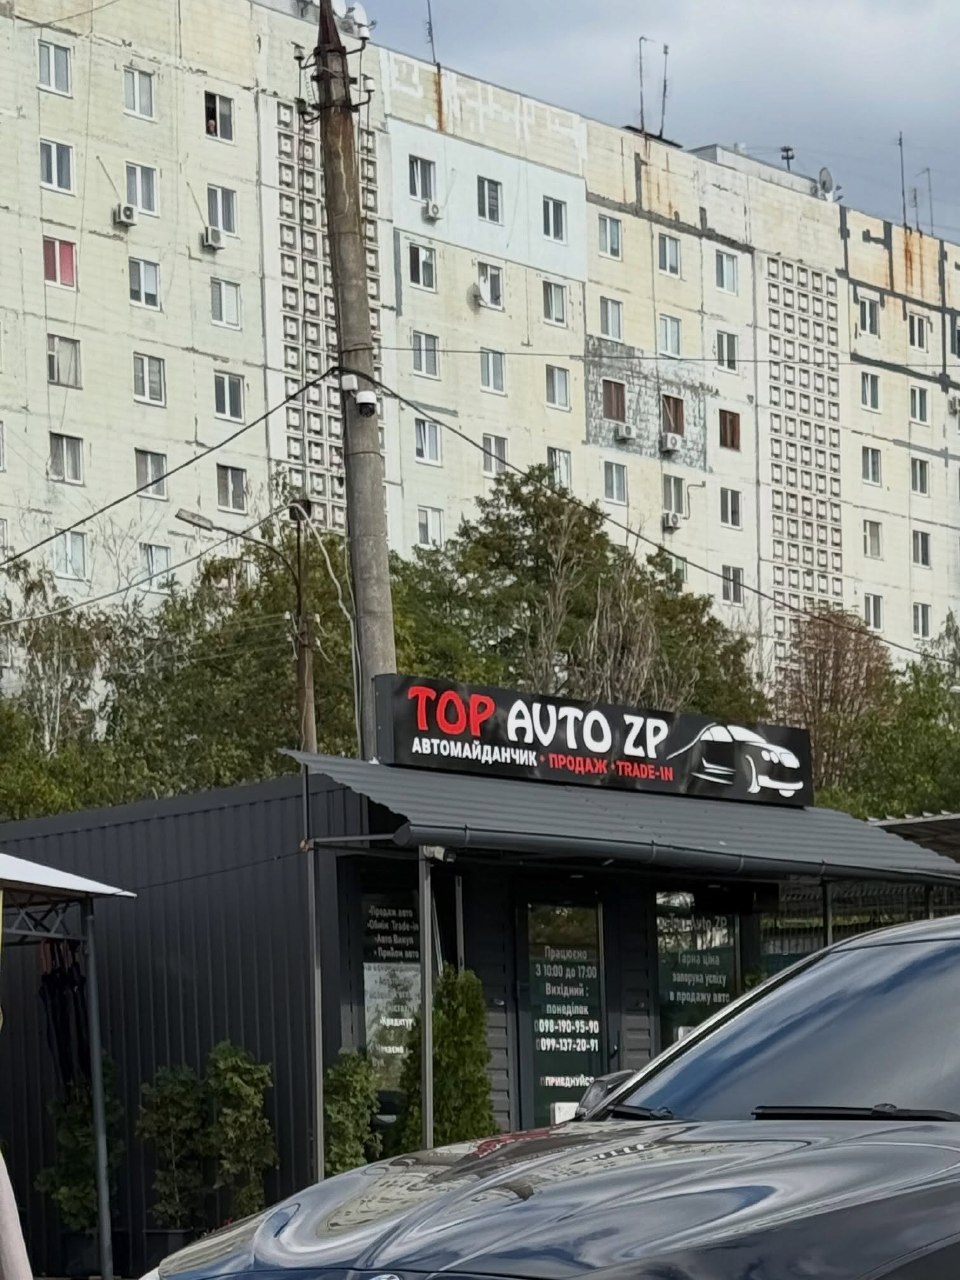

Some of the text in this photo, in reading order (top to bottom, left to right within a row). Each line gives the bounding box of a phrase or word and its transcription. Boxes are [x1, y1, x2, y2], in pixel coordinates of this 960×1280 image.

[408, 686, 669, 760] TOP AVTO ZP
[411, 736, 674, 781] АВТОМАЙДАНЧИК ПРОДАЖ TRADE-IN
[543, 964, 563, 978] 10:00
[565, 967, 576, 980] до
[578, 965, 597, 978] 17:00
